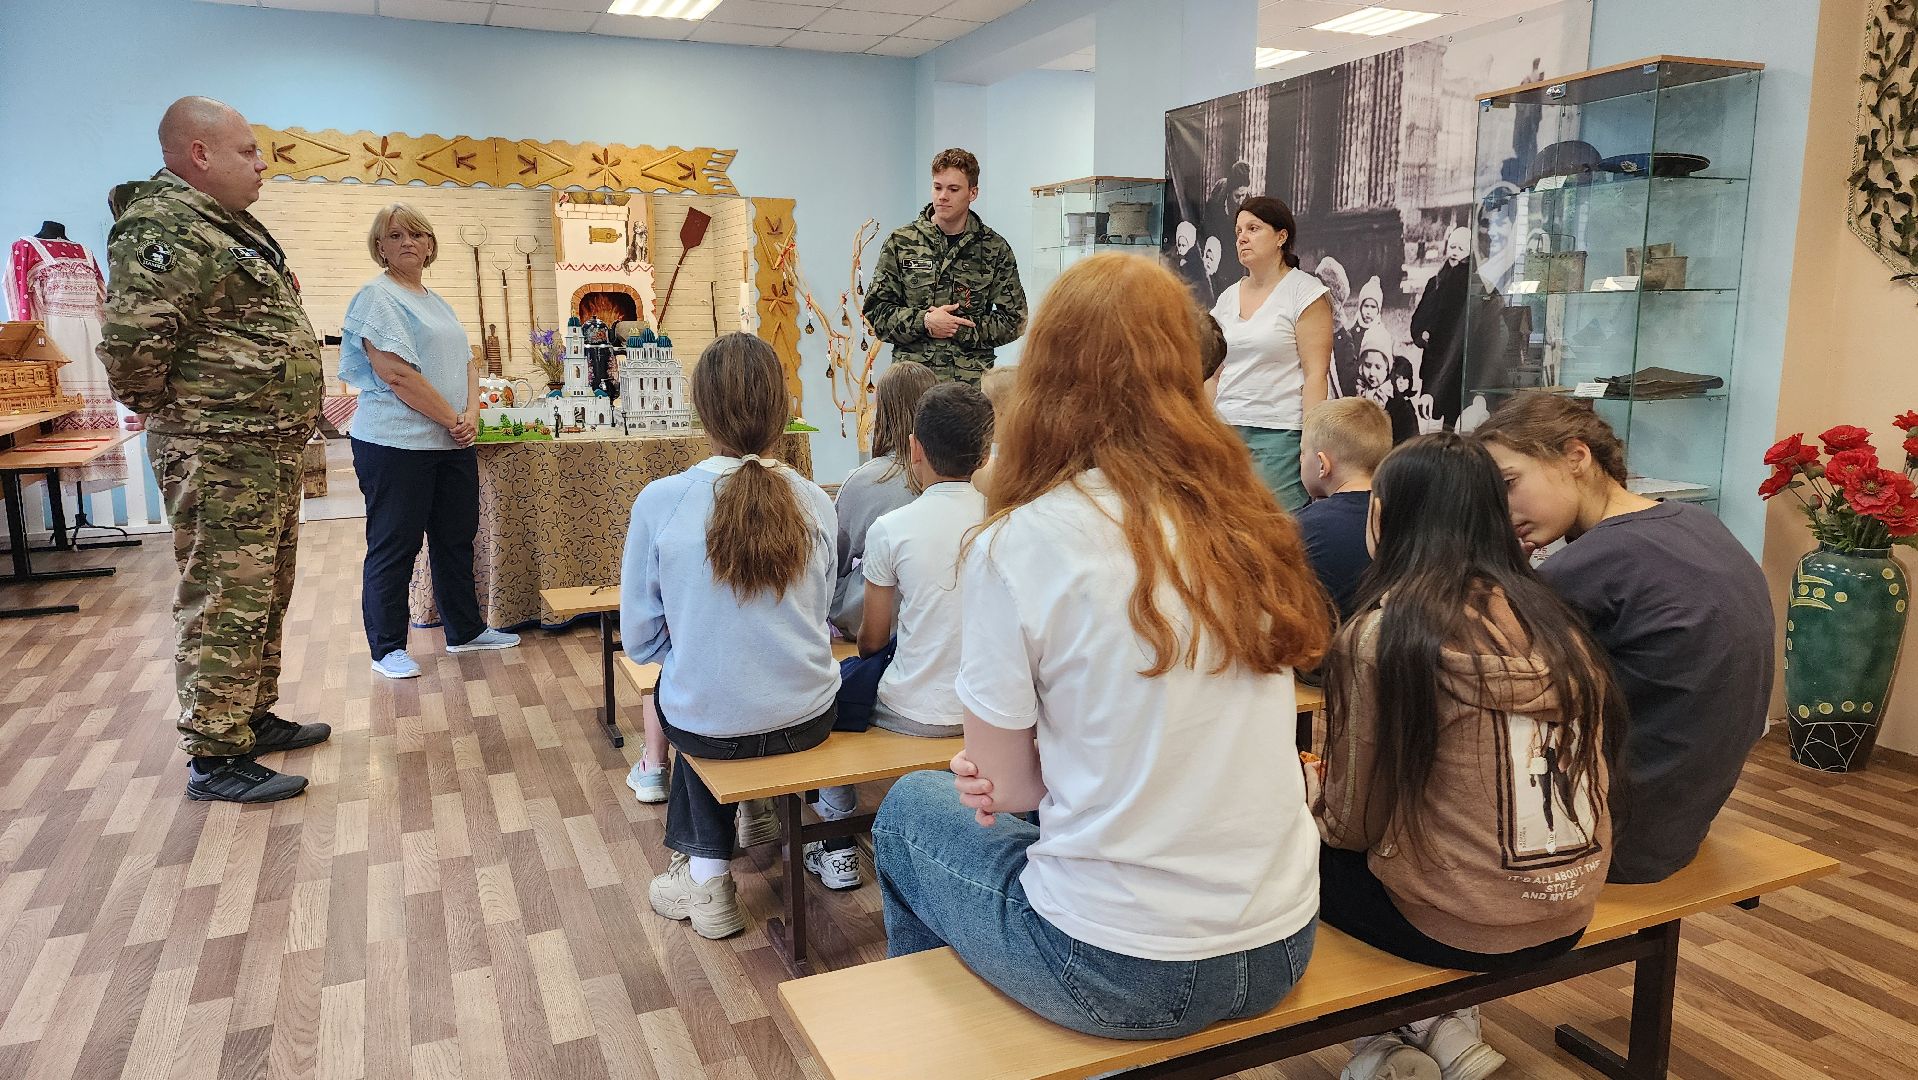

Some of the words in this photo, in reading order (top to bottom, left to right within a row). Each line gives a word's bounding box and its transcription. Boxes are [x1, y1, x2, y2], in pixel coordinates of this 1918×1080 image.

[1532, 875, 1554, 884] ALL
[1555, 866, 1584, 882] ABOUT
[1545, 879, 1577, 893] STYLE
[1521, 891, 1547, 900] AND
